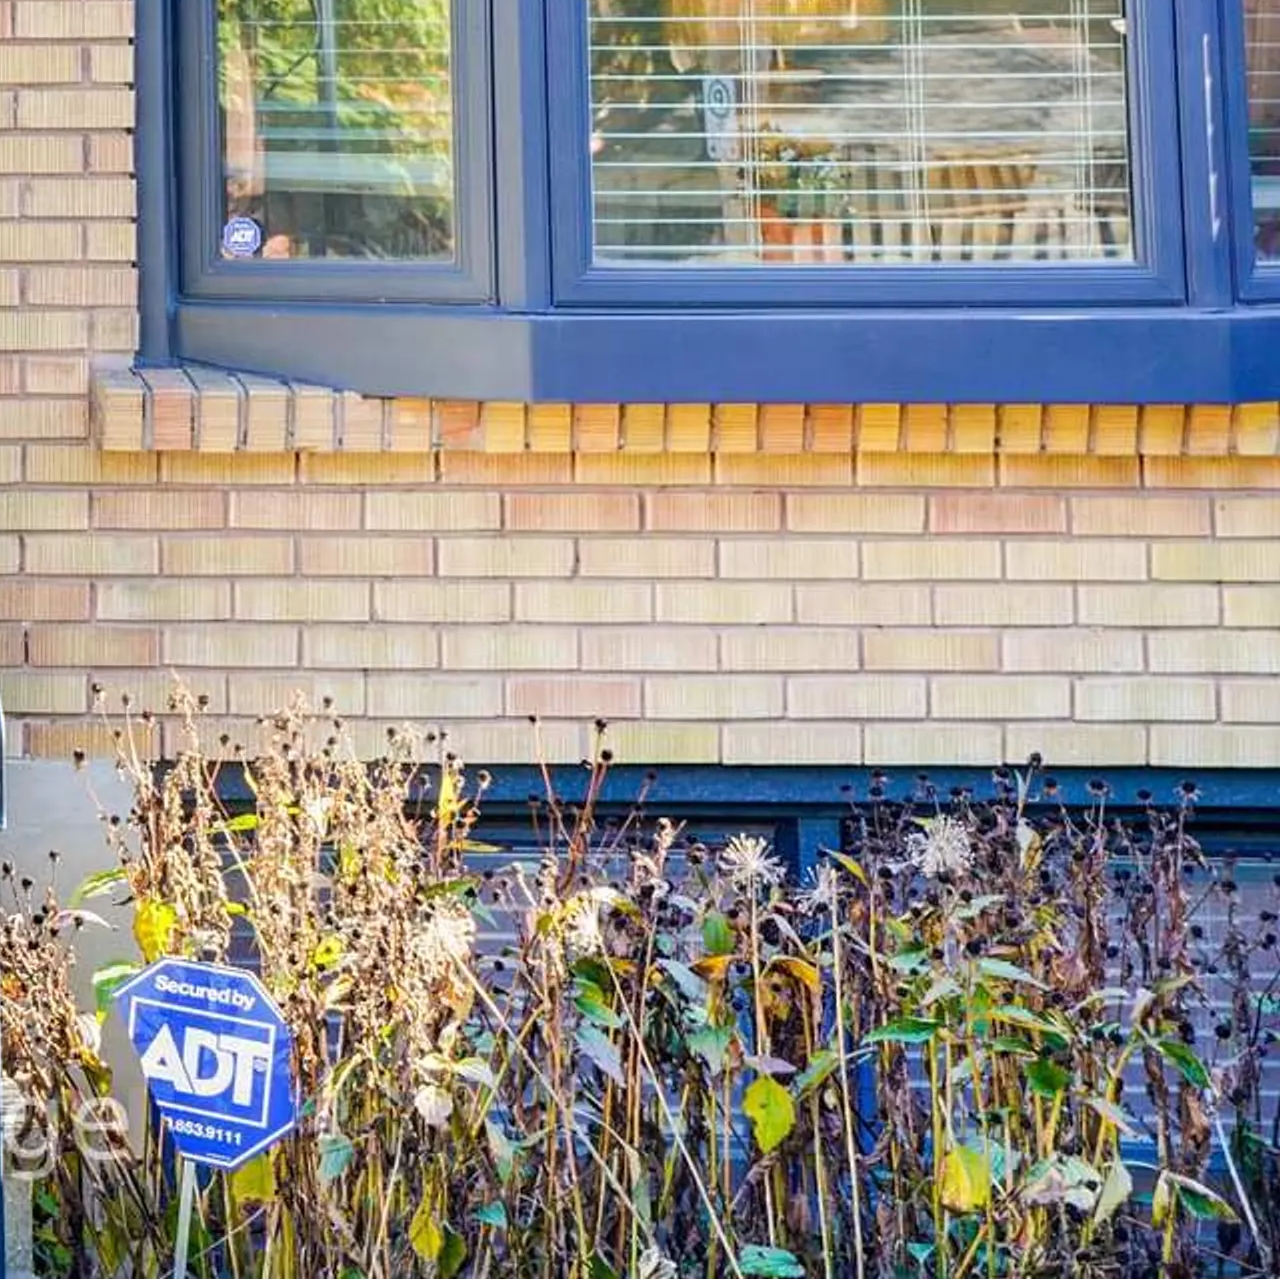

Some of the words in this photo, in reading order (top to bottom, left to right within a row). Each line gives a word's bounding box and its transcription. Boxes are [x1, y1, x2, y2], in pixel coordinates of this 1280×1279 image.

[154, 974, 231, 1002] Secured
[232, 989, 256, 1011] by
[141, 1023, 272, 1107] ADT
